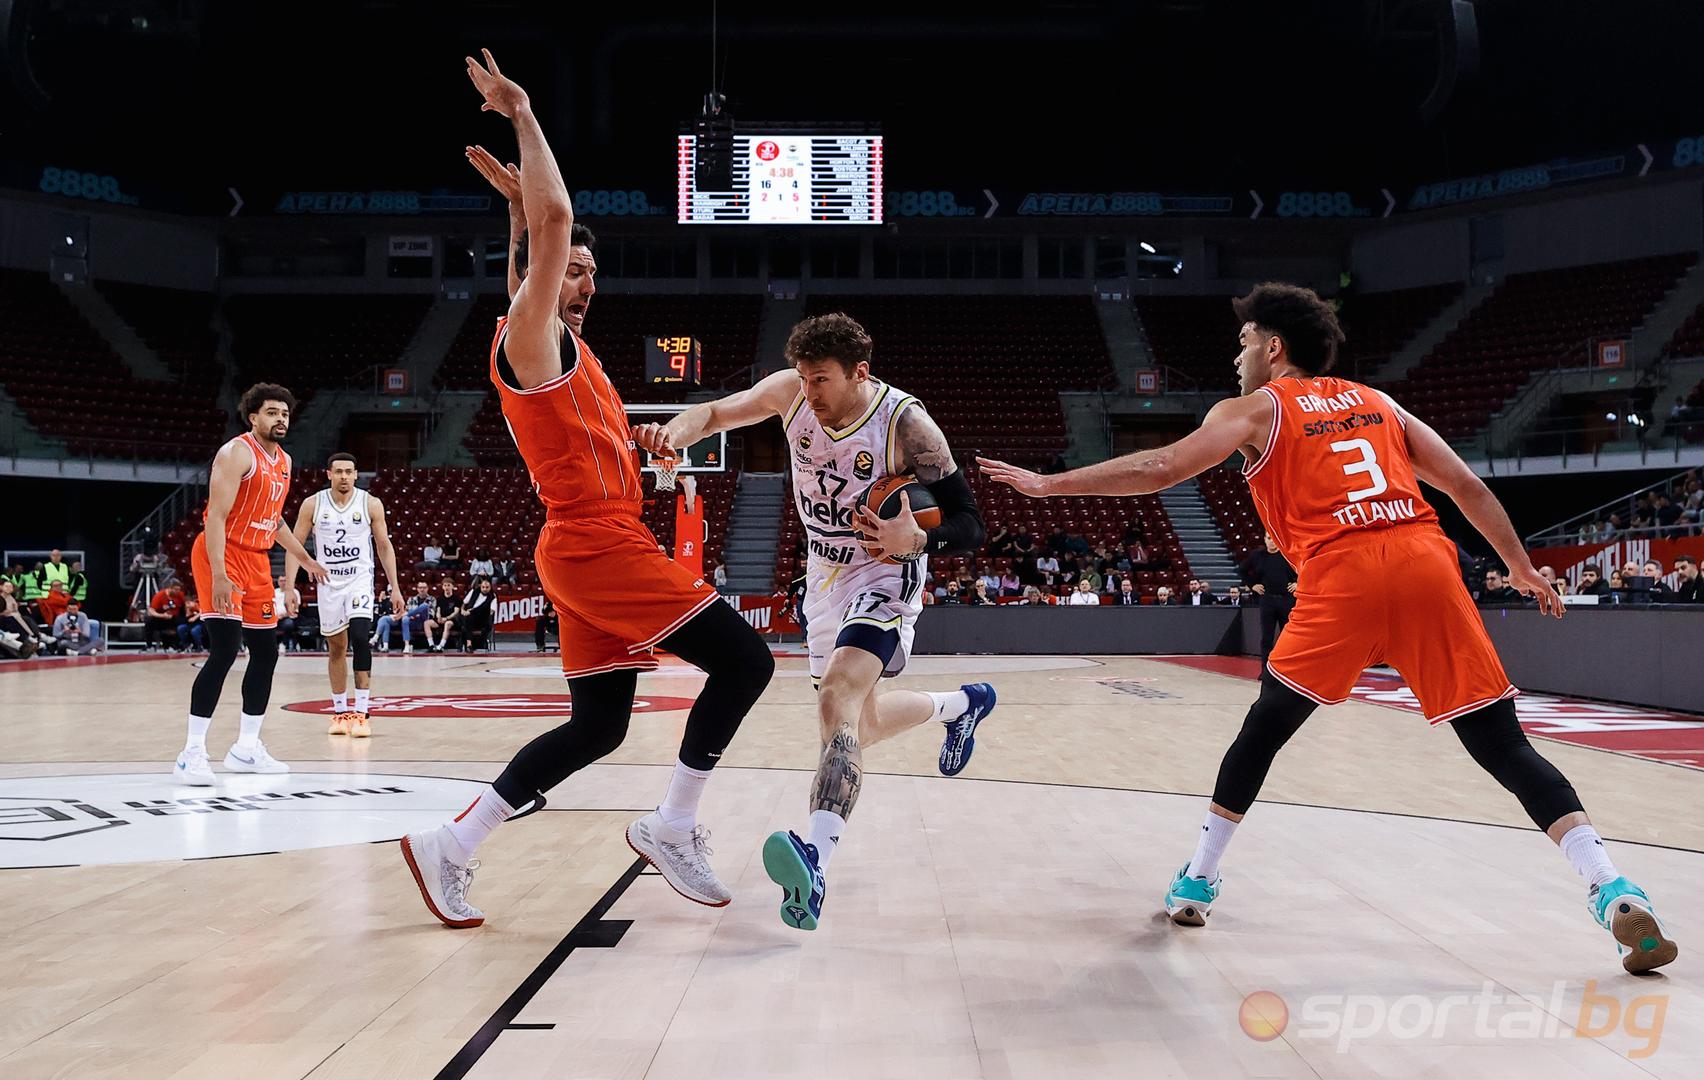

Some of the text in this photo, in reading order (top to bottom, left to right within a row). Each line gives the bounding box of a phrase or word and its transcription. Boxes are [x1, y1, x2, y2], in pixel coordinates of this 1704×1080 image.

[760, 180, 772, 189] 16
[792, 180, 798, 189] 4
[761, 192, 768, 202] 2
[792, 192, 800, 202] 5
[656, 336, 691, 353] 4:38
[670, 355, 686, 378] 9
[1295, 389, 1366, 414] BRYANT
[1330, 438, 1388, 502] 3
[271, 481, 284, 502] 17
[815, 470, 849, 498] 17
[336, 529, 347, 543] 2
[324, 544, 360, 558] beko
[810, 539, 856, 564] misli
[330, 566, 357, 576] misli
[361, 594, 370, 609] 2
